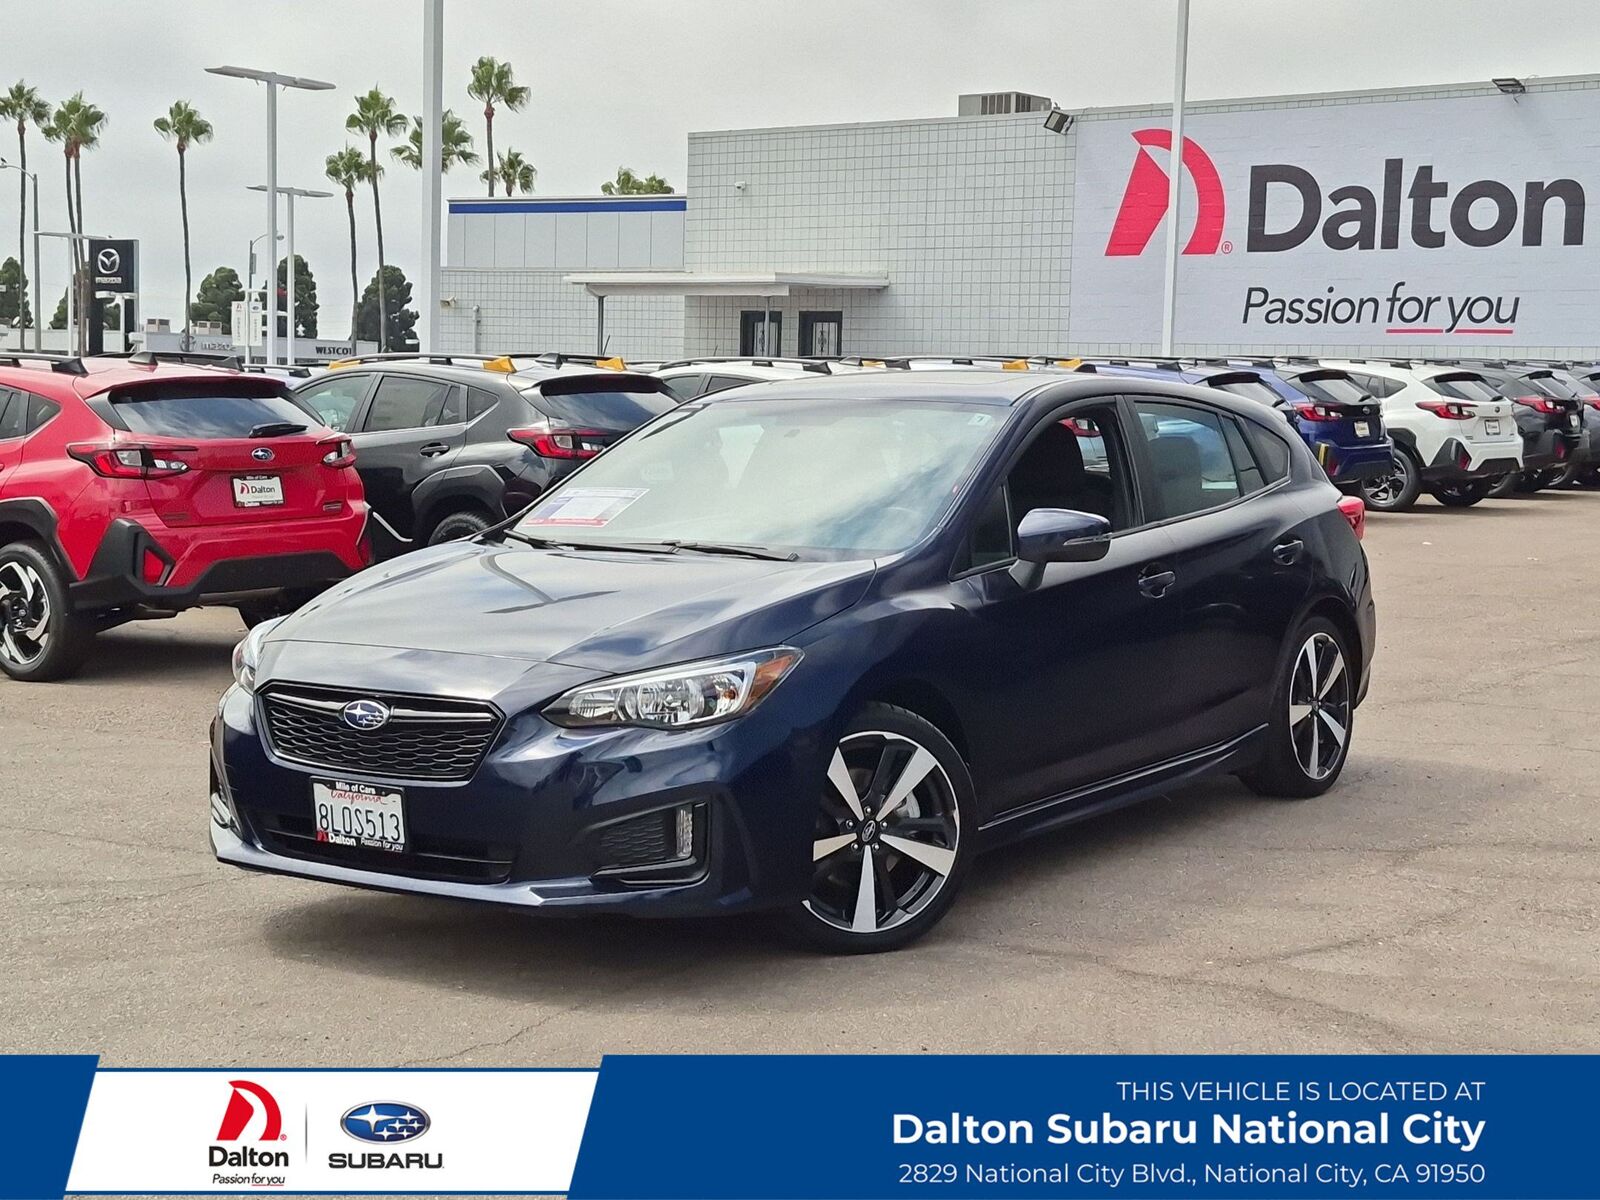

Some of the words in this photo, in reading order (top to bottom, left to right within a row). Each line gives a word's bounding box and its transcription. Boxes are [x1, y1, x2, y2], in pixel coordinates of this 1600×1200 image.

[1246, 158, 1586, 253] Dalton
[1242, 286, 1380, 325] Passion
[1385, 281, 1442, 325] for
[1446, 296, 1519, 333] you
[251, 485, 276, 494] Dalton
[335, 781, 350, 790] Mile
[351, 784, 359, 792] of
[359, 785, 376, 794] Cars
[330, 790, 388, 805] California
[328, 832, 357, 847] Dalton
[382, 840, 392, 849] for
[391, 843, 404, 851] you
